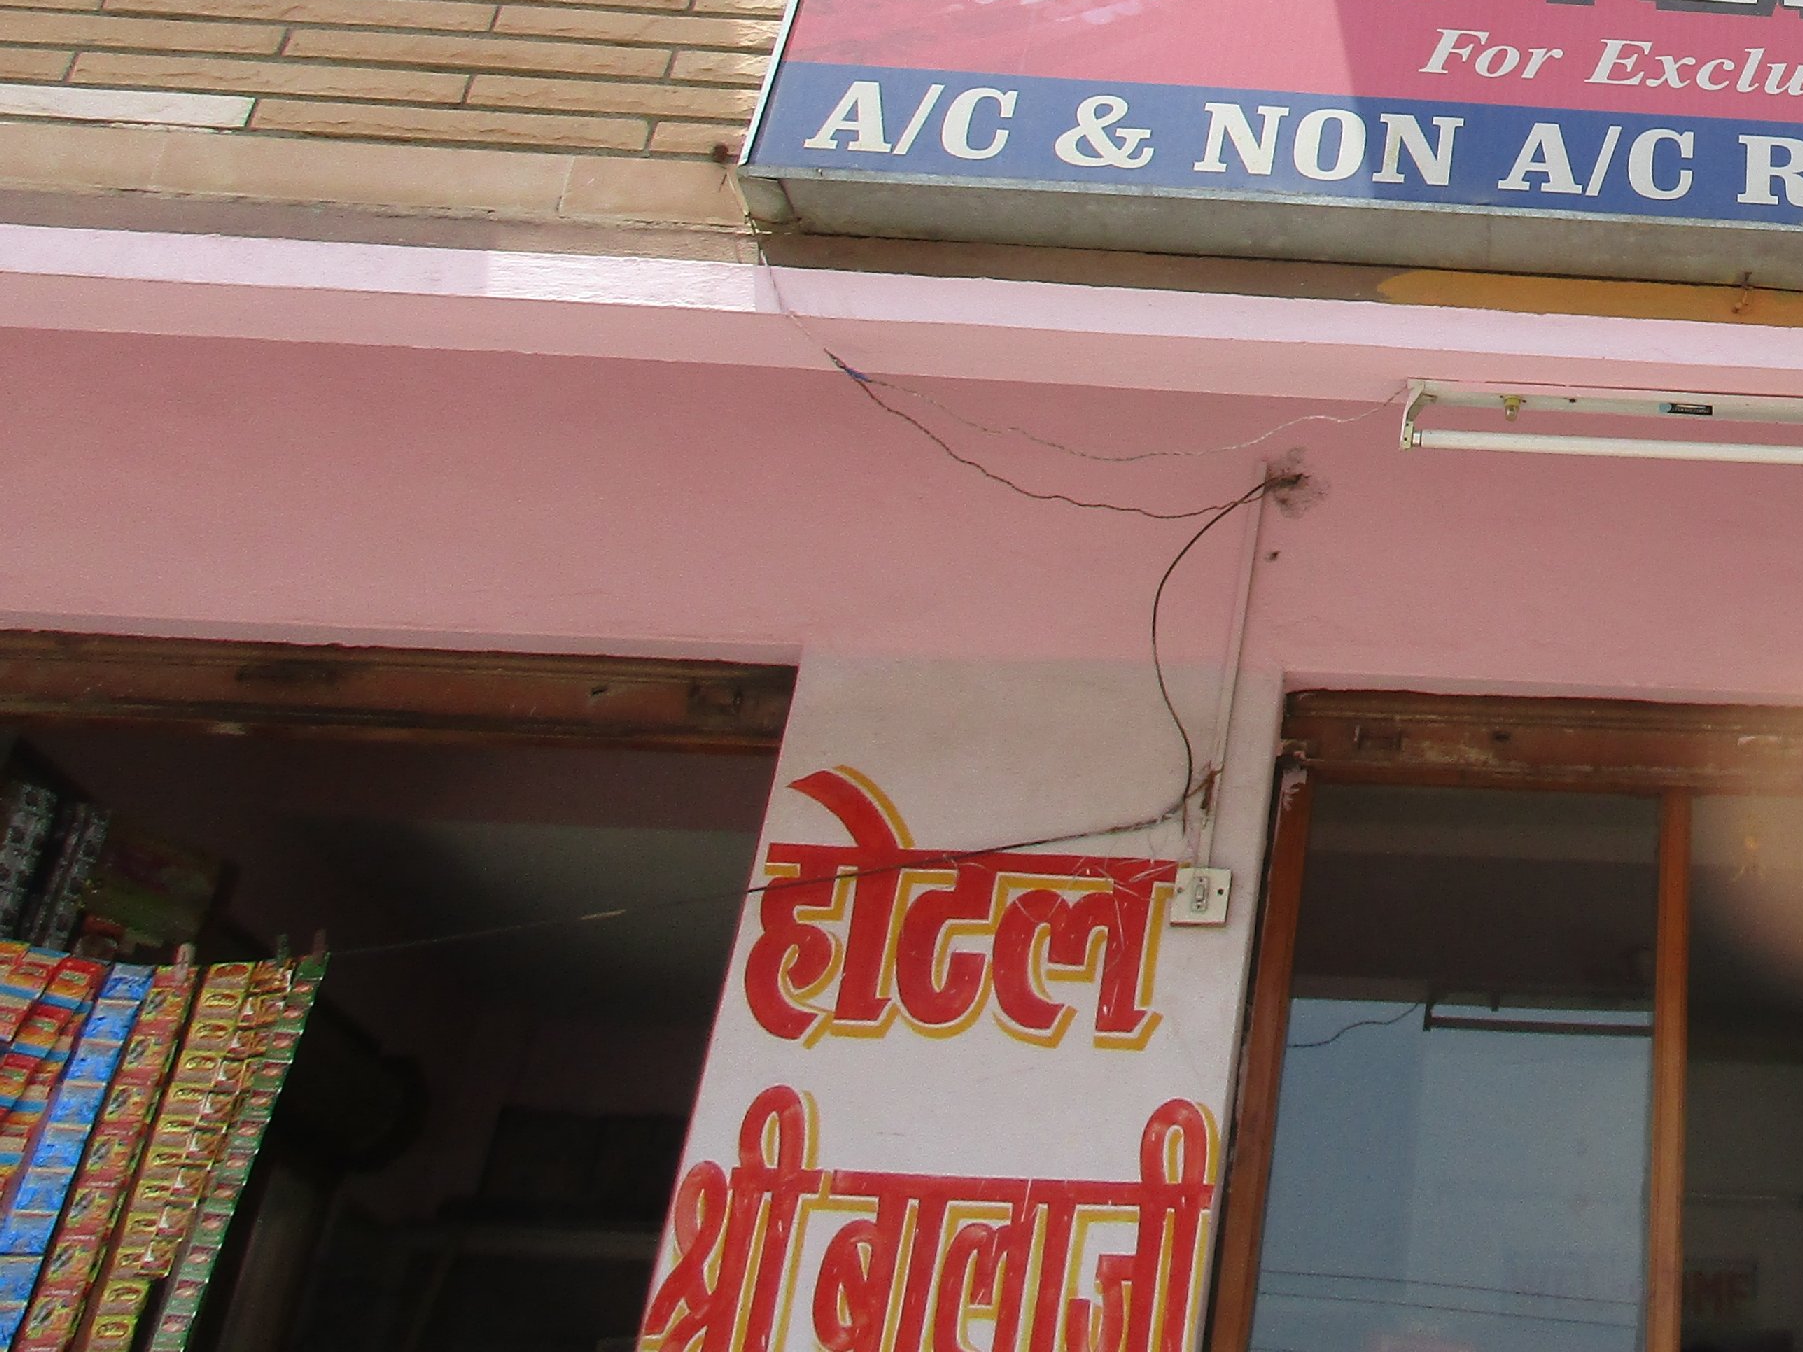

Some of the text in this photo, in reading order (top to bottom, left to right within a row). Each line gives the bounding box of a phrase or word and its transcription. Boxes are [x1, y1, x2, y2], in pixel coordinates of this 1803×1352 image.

[803, 79, 1021, 162] A/C
[1053, 94, 1155, 170] &
[1193, 101, 1465, 188] NON
[1497, 121, 1696, 205] A/C
[1417, 27, 1565, 81] For
[744, 765, 1181, 1049] होटल
[636, 1084, 1217, 1352] श्री बालाजी
